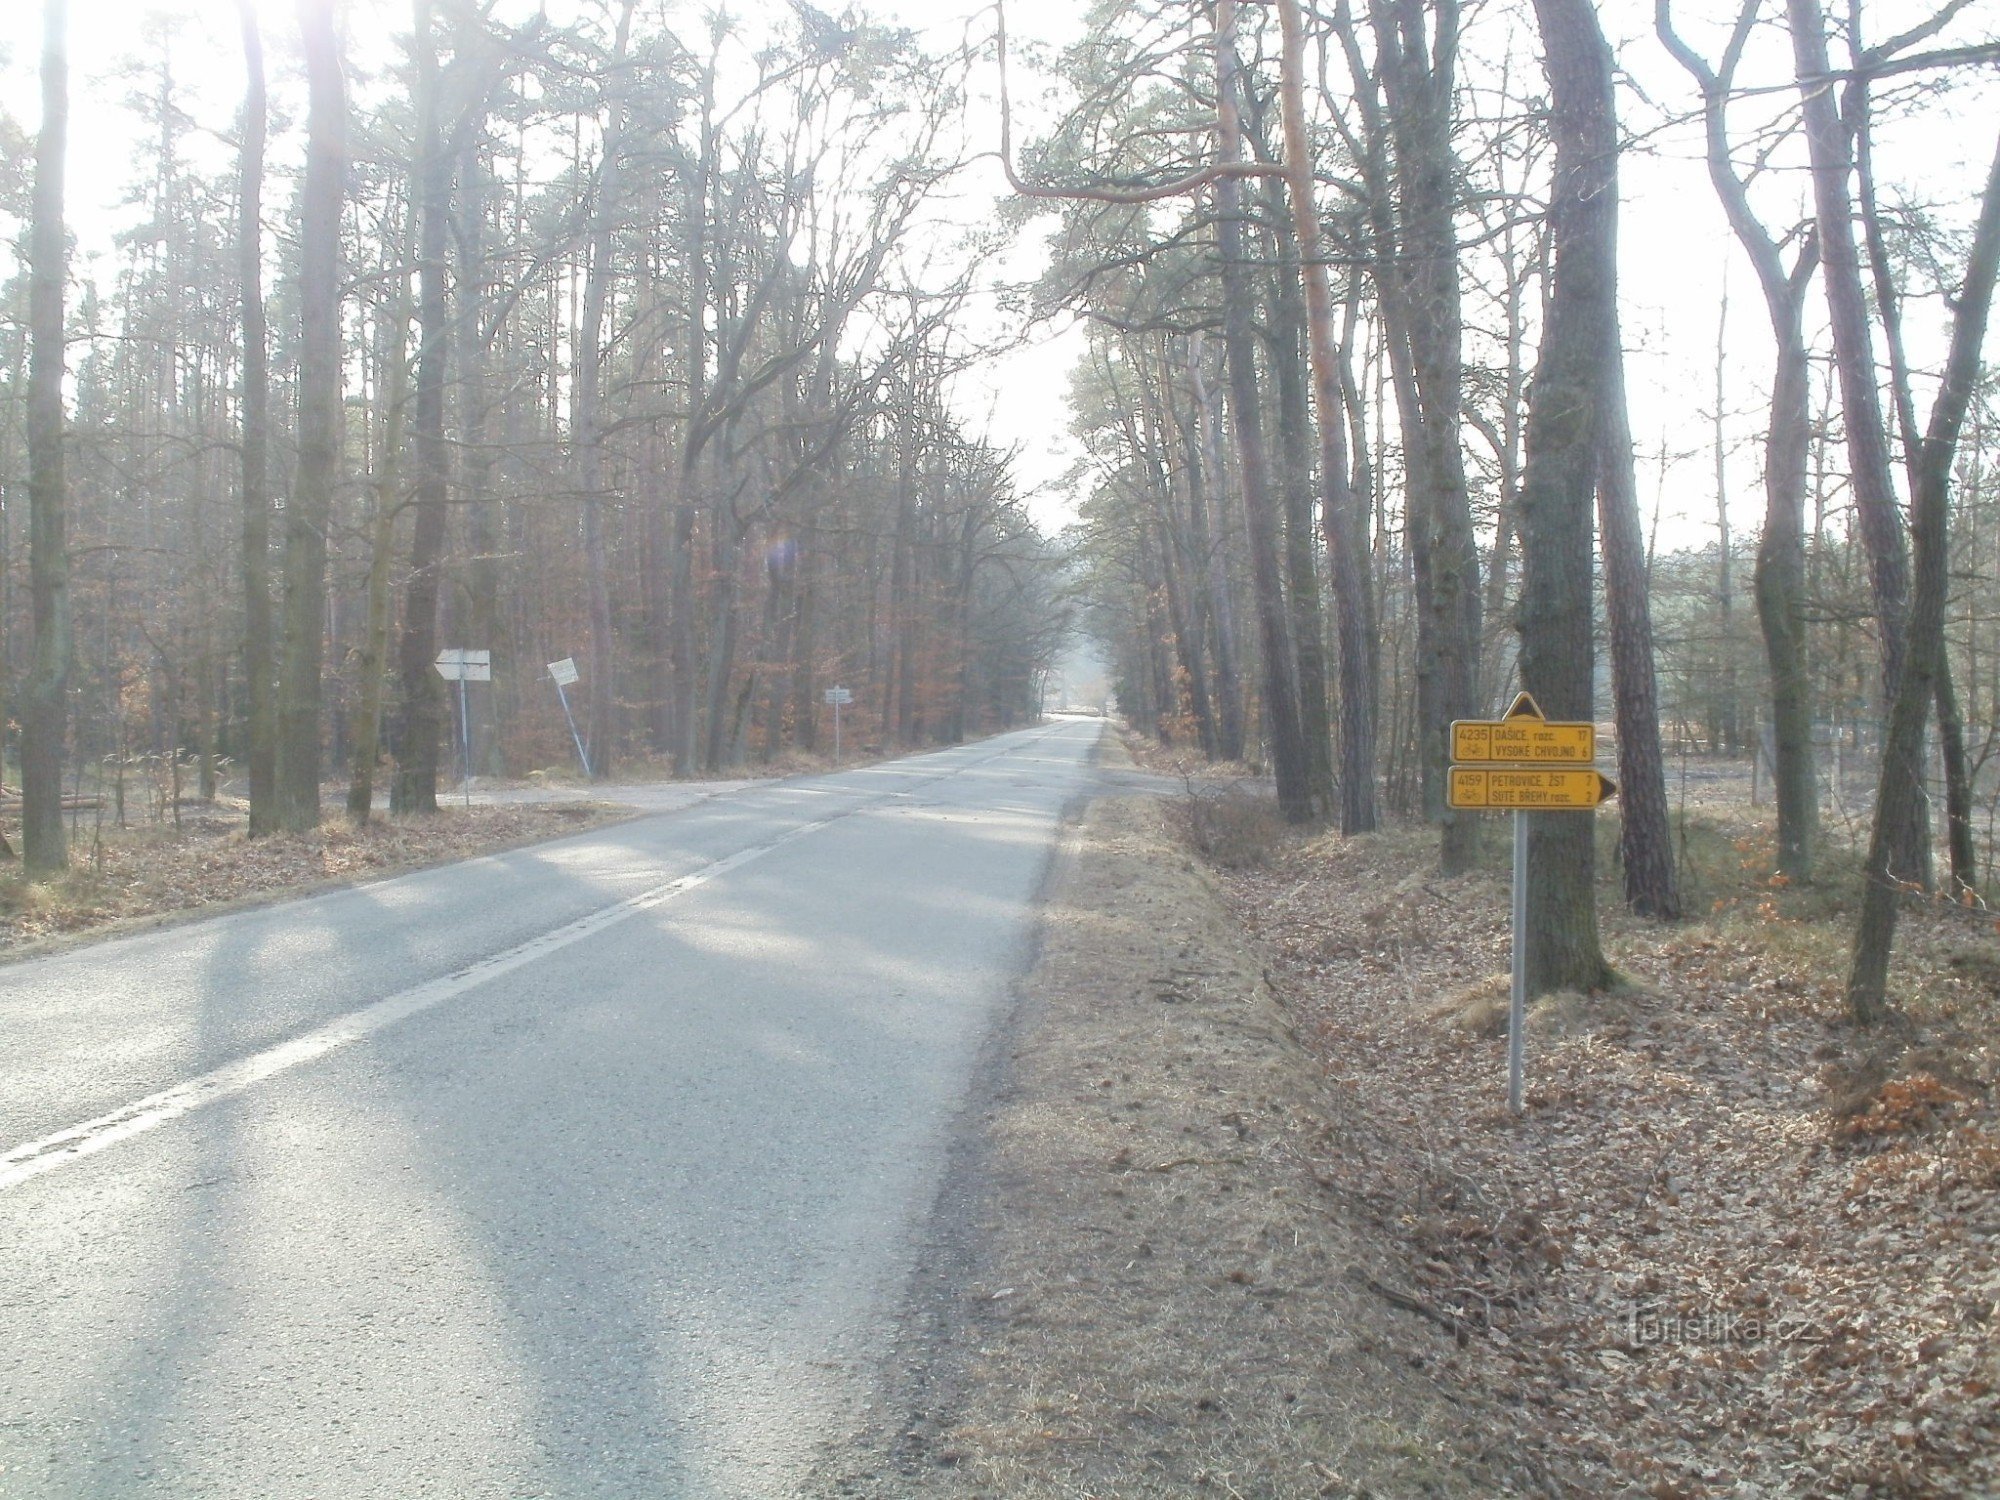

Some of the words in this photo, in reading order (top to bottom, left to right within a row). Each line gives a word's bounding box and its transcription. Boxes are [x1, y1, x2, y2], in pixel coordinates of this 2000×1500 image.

[1459, 729, 1488, 741] 4235
[1577, 730, 1587, 742] 17
[1495, 743, 1530, 757] VYSOKÉ
[1534, 745, 1576, 757] CHVOJNO
[1582, 746, 1588, 758] 6
[1457, 774, 1482, 786] 4159
[1584, 774, 1591, 787] 7
[1518, 788, 1548, 802] BŘEHY
[1583, 790, 1591, 803] 2
